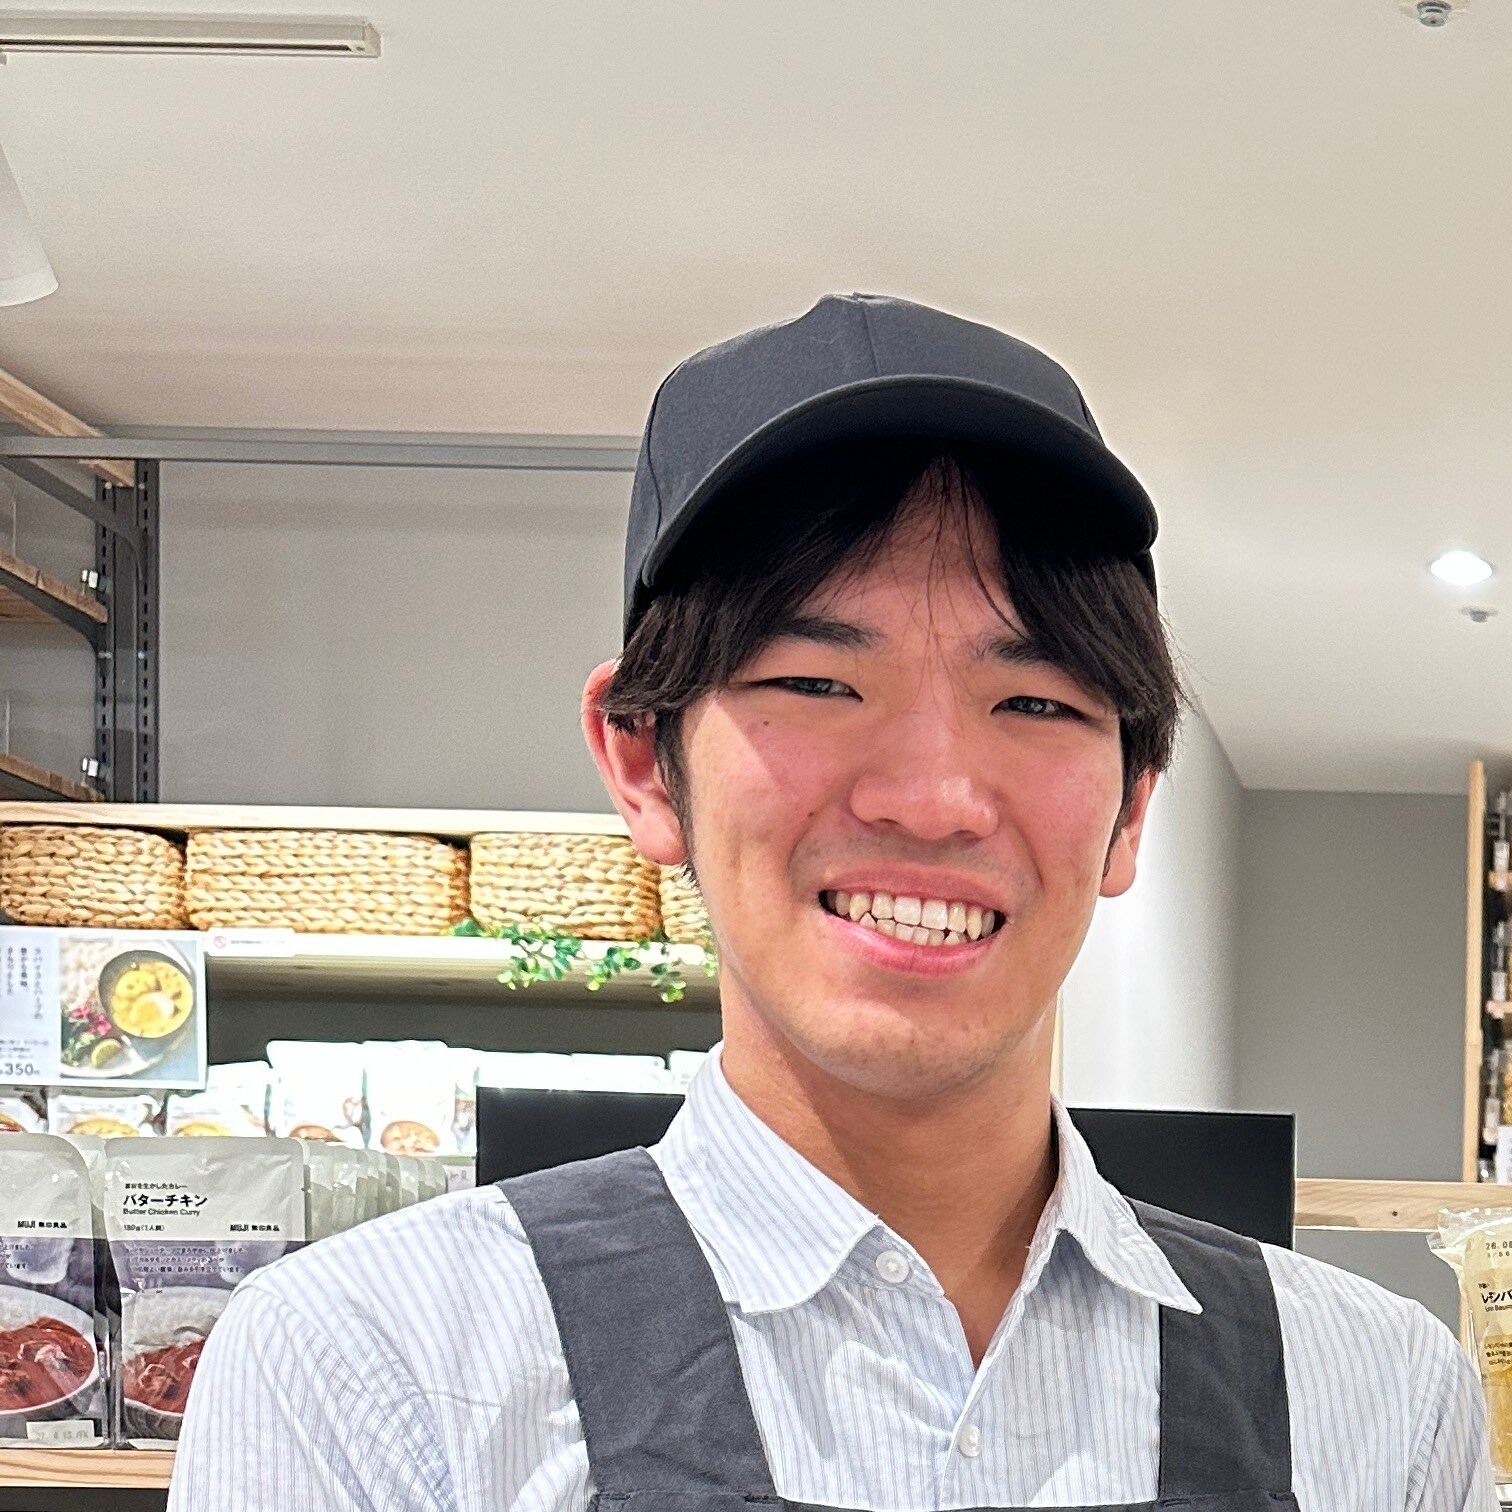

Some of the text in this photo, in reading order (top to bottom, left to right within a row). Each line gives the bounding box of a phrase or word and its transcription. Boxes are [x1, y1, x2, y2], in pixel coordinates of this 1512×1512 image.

[123, 1194, 208, 1208] バターチキン
